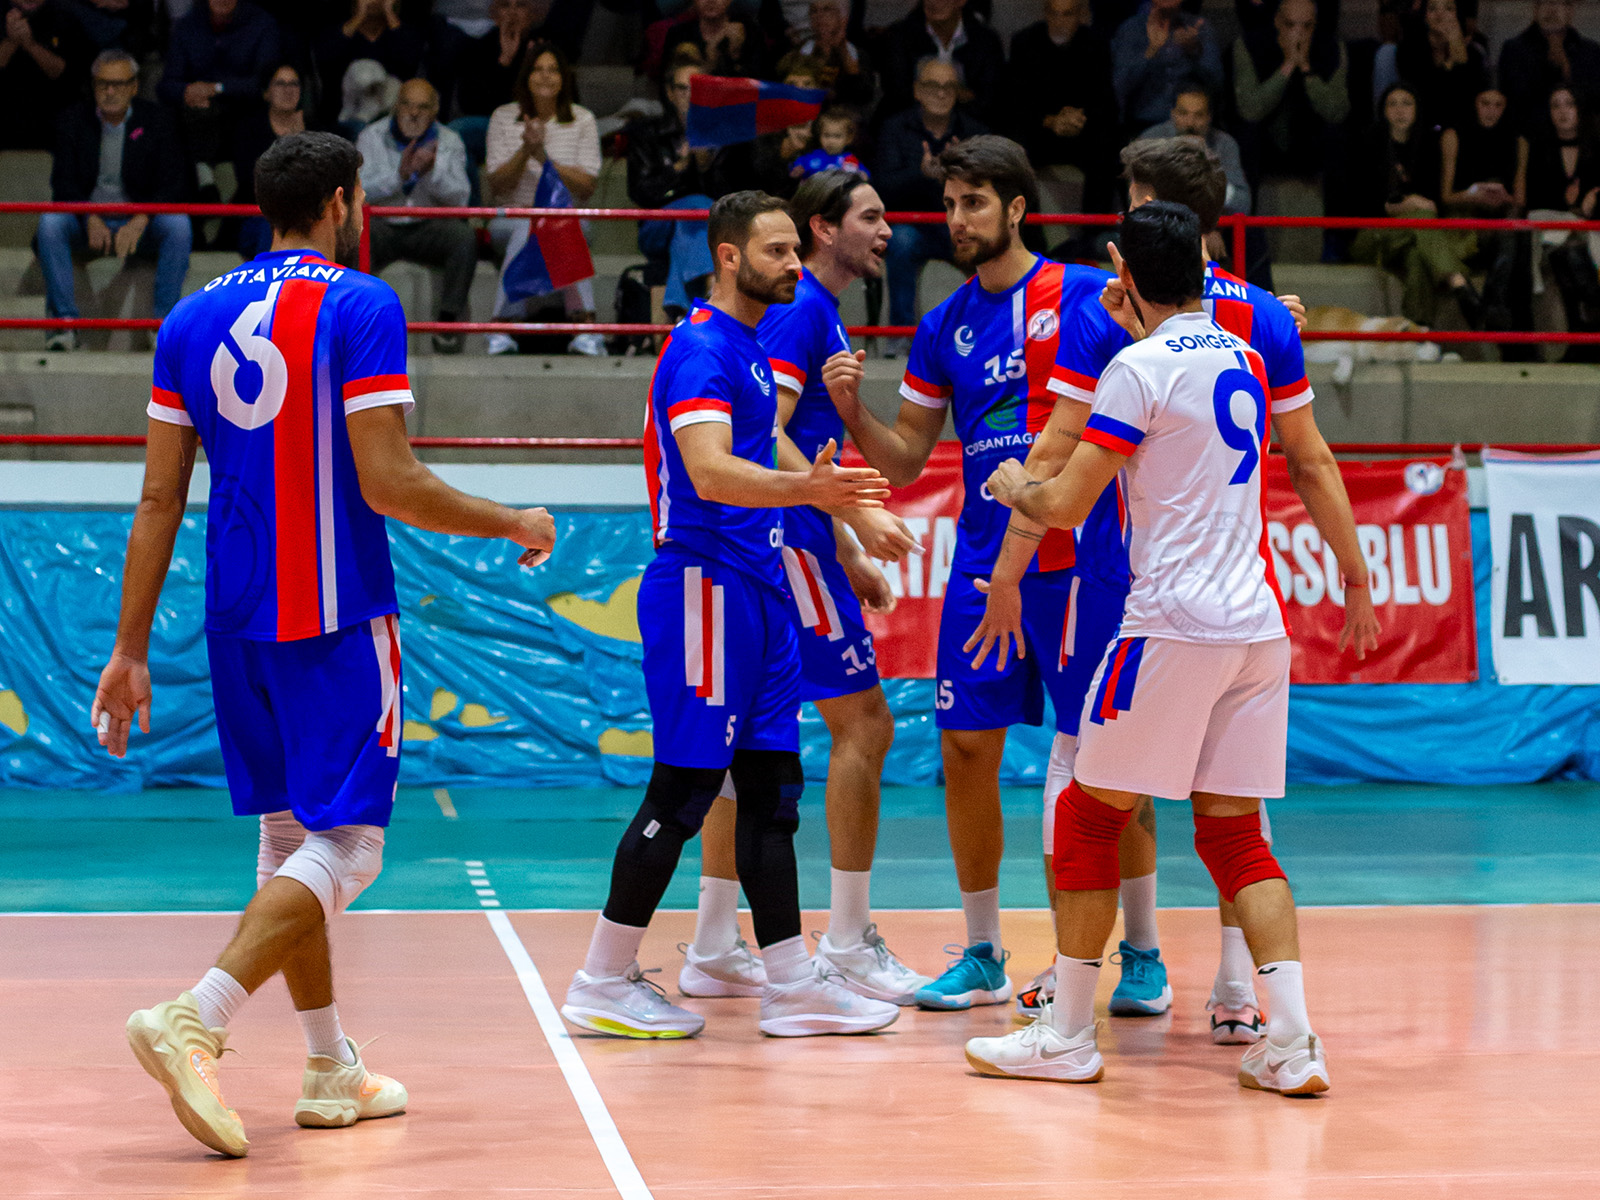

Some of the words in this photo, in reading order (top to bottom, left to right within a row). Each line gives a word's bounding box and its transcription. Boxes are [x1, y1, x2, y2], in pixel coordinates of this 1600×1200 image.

[204, 265, 344, 292] OTTAVIANI
[210, 300, 288, 431] 6
[984, 348, 1027, 385] 15
[1212, 368, 1267, 486] 9
[841, 635, 876, 676] 13
[725, 715, 737, 747] 5
